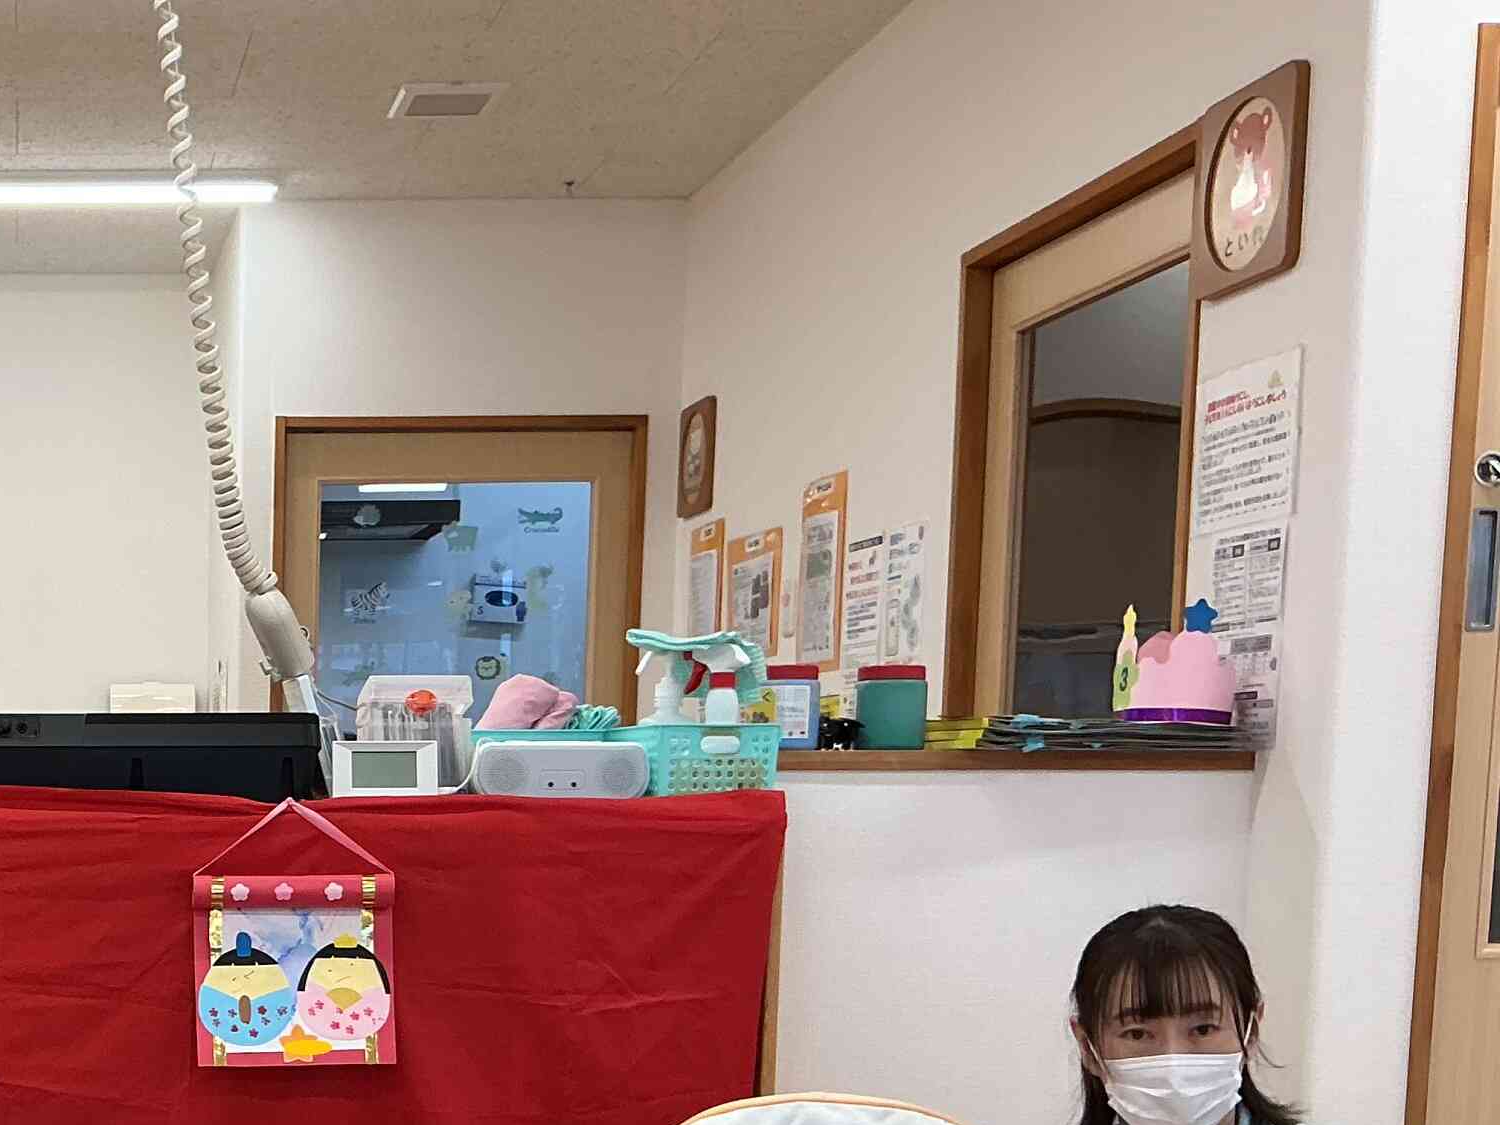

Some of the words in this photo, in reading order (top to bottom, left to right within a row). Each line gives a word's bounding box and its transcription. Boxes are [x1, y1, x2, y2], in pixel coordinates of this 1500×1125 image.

[1224, 224, 1268, 257] といれ
[1119, 667, 1129, 692] 3
